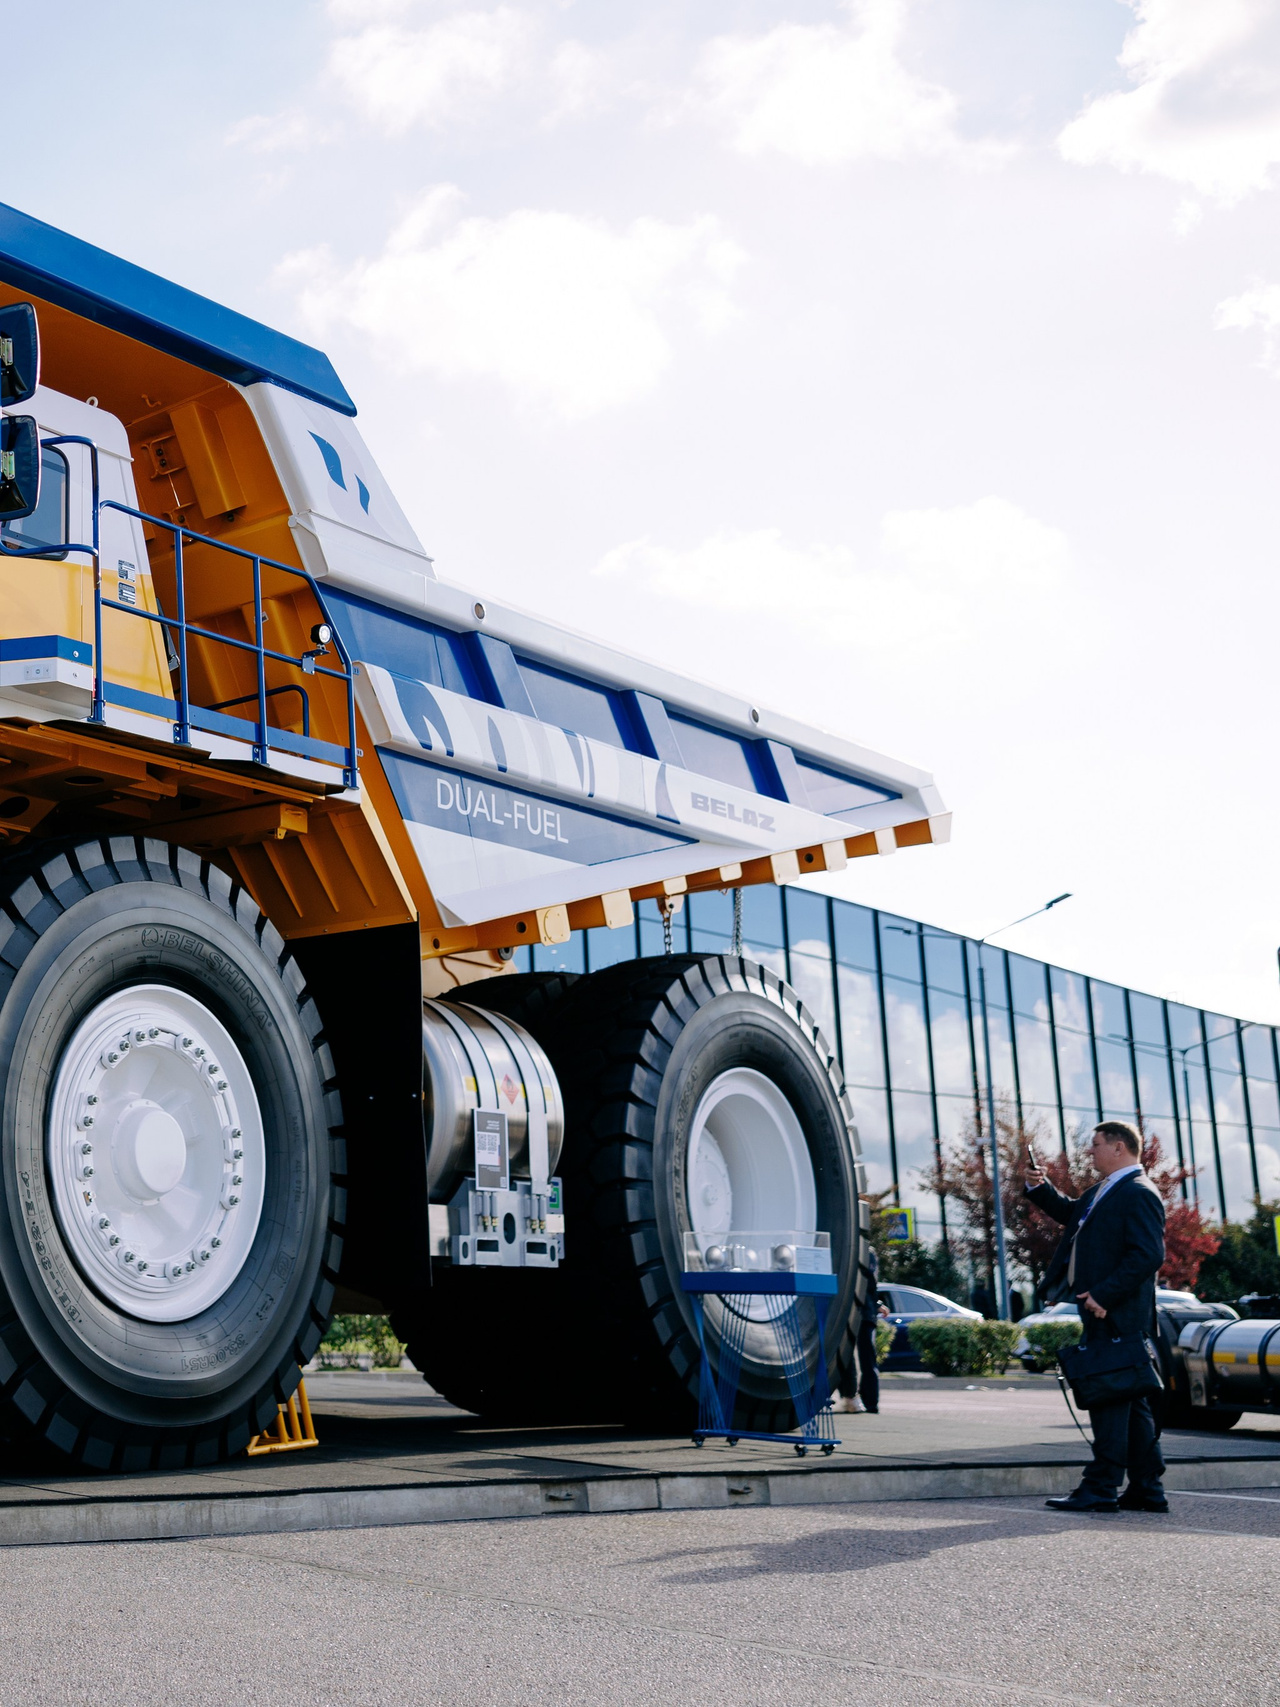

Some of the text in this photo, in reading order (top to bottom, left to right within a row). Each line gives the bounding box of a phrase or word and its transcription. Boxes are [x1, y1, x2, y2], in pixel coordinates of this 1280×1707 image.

[436, 777, 569, 844] DUAL-FUEL
[690, 791, 776, 833] BELAZ
[162, 930, 269, 1030] BELSHINA
